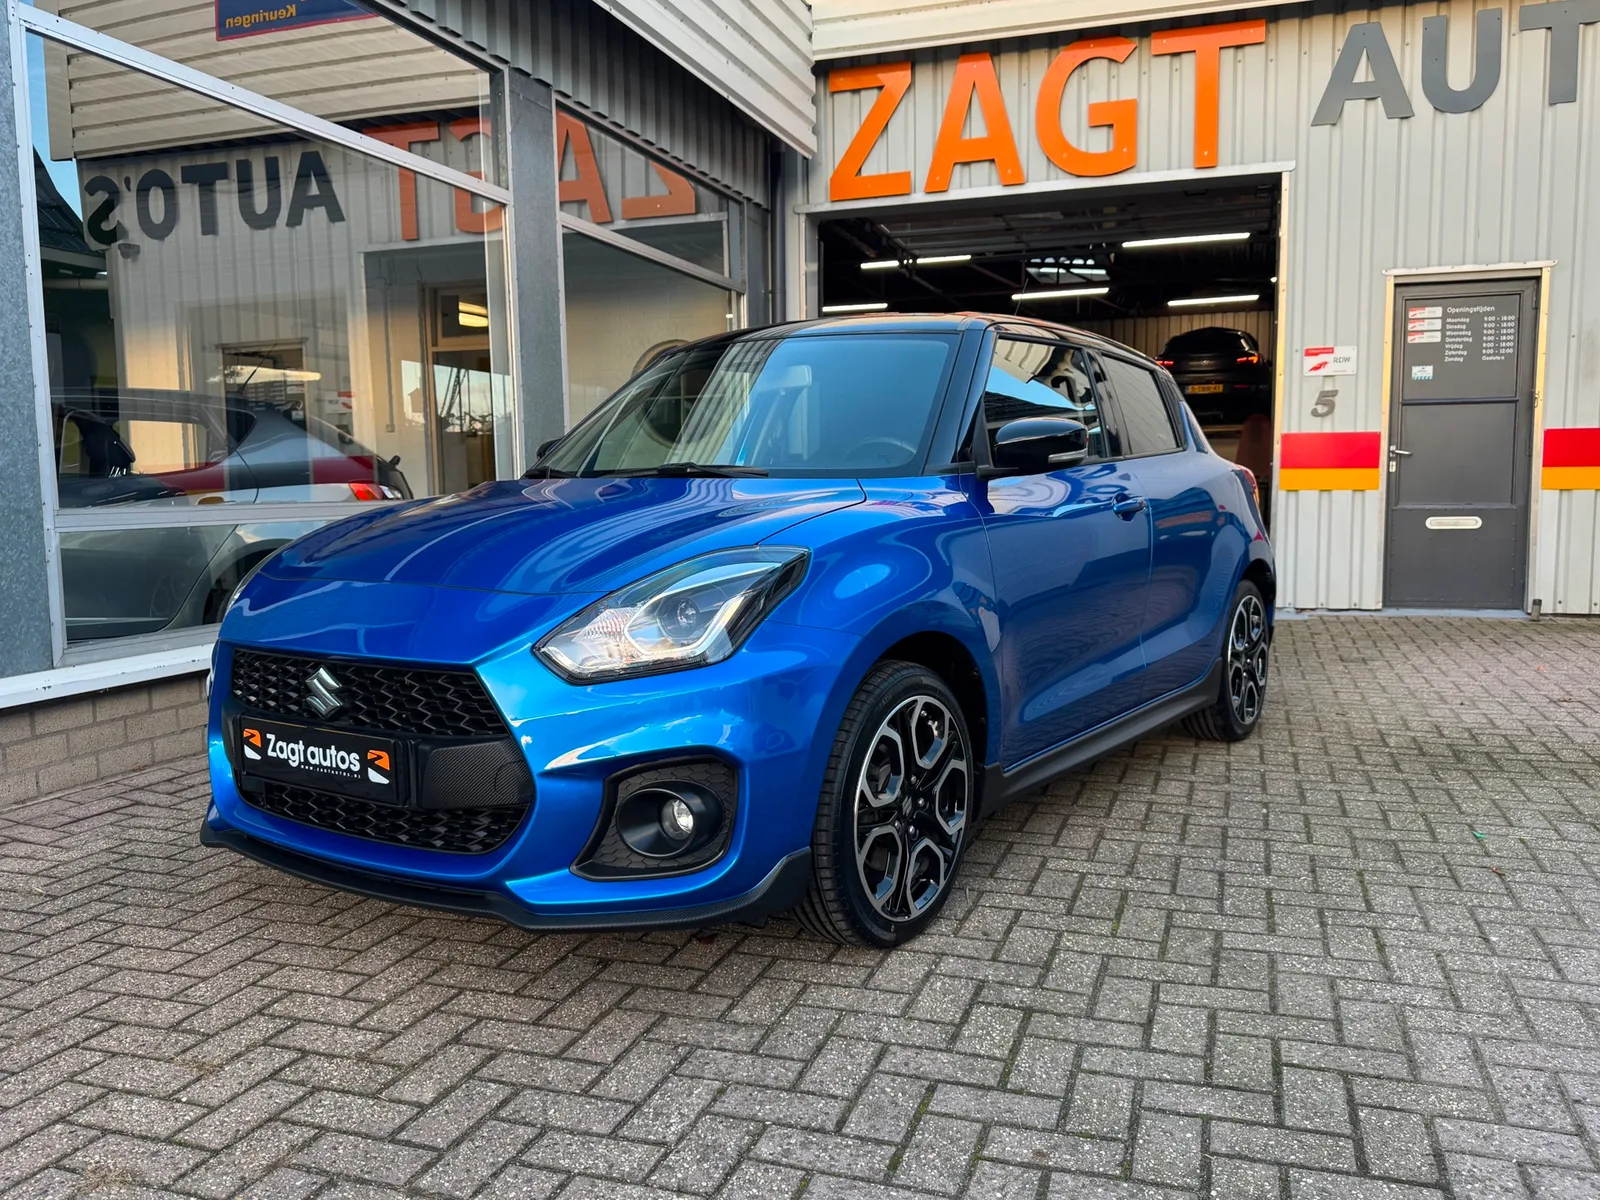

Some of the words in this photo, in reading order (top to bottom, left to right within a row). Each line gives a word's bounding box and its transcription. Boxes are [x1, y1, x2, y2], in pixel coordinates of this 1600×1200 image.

[829, 19, 1266, 201] ZAGT
[1311, 0, 1600, 127] AUT
[1447, 306, 1495, 314] Openingstijden
[1310, 390, 1339, 418] 5
[266, 733, 304, 768] Zagt
[307, 745, 360, 772] autos
